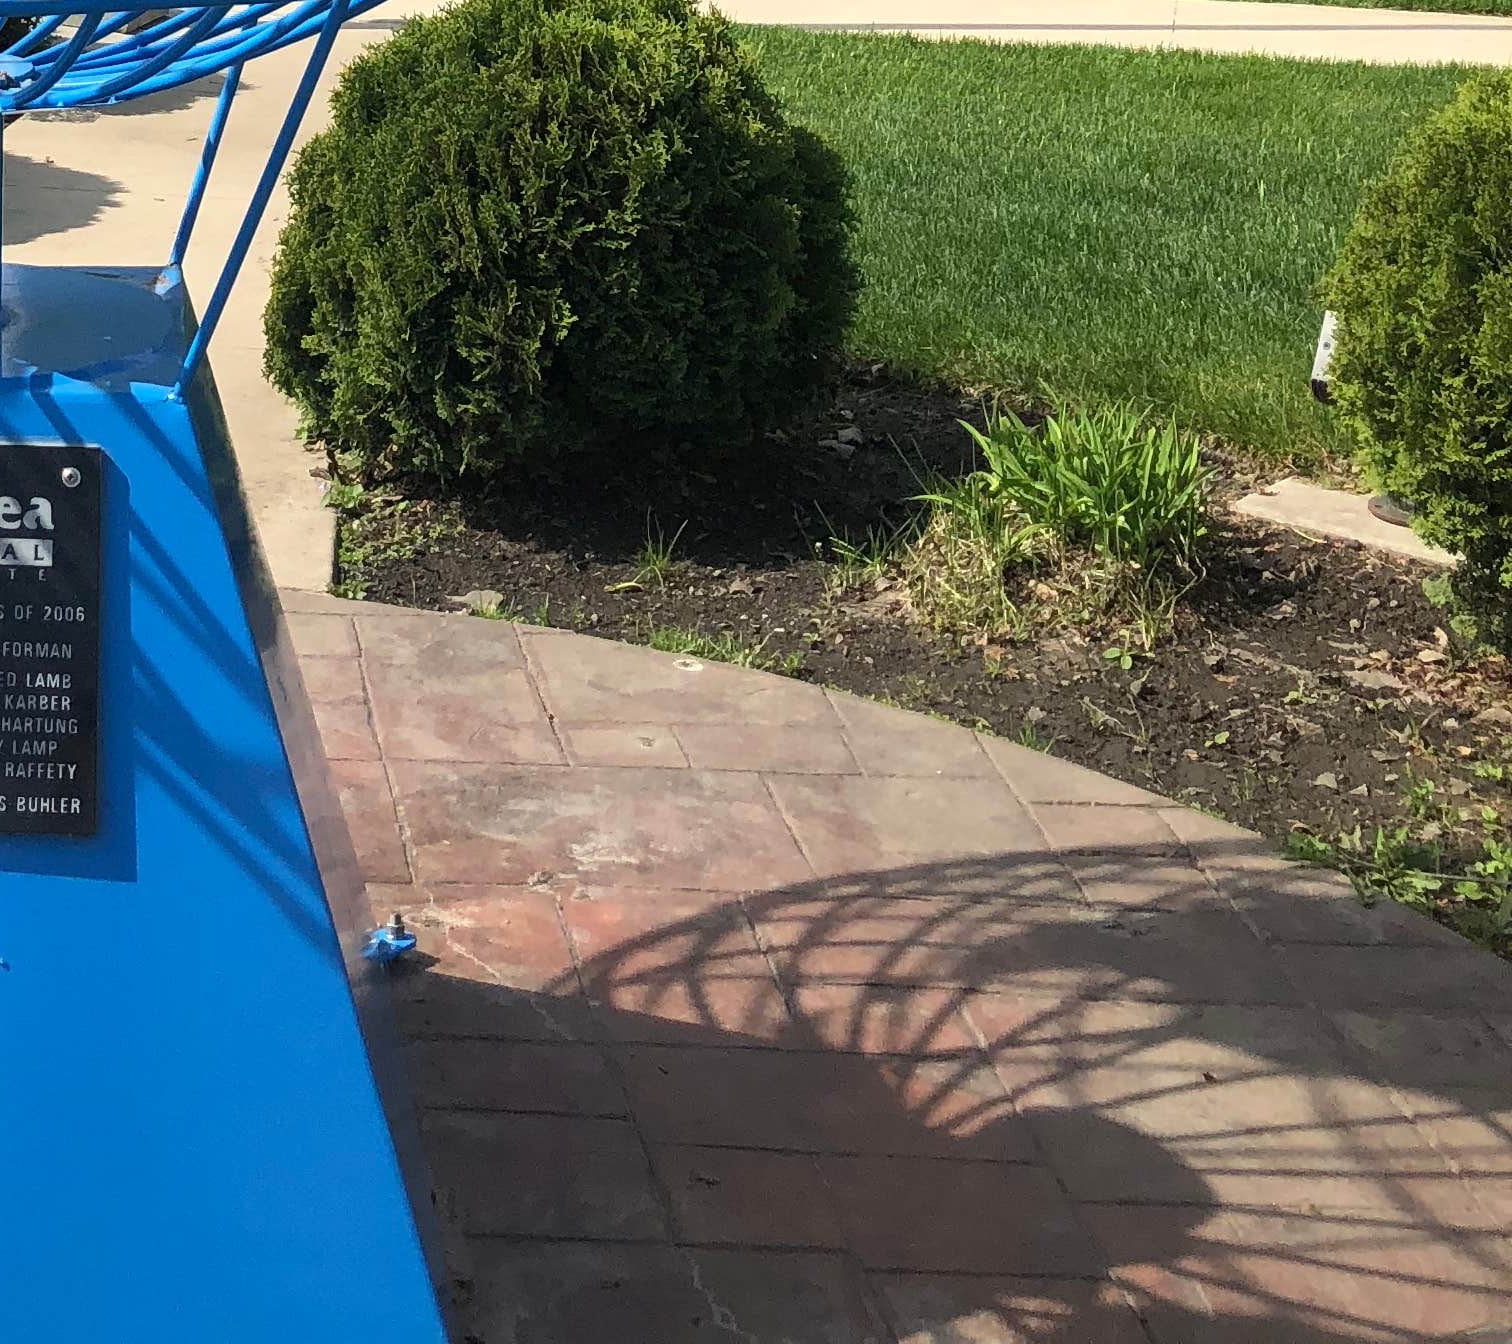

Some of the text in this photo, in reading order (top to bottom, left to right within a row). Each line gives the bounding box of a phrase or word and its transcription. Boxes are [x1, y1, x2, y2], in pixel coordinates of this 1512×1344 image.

[13, 604, 34, 621] OF
[42, 605, 86, 623] 2006
[2, 640, 73, 659] FORMAN
[26, 672, 73, 690] LAMB
[4, 694, 72, 712] KARBER
[1, 716, 80, 735] HARTUNG
[12, 739, 59, 757] LAMP
[4, 761, 78, 781] RAFFETY
[16, 795, 82, 814] BUHLER
